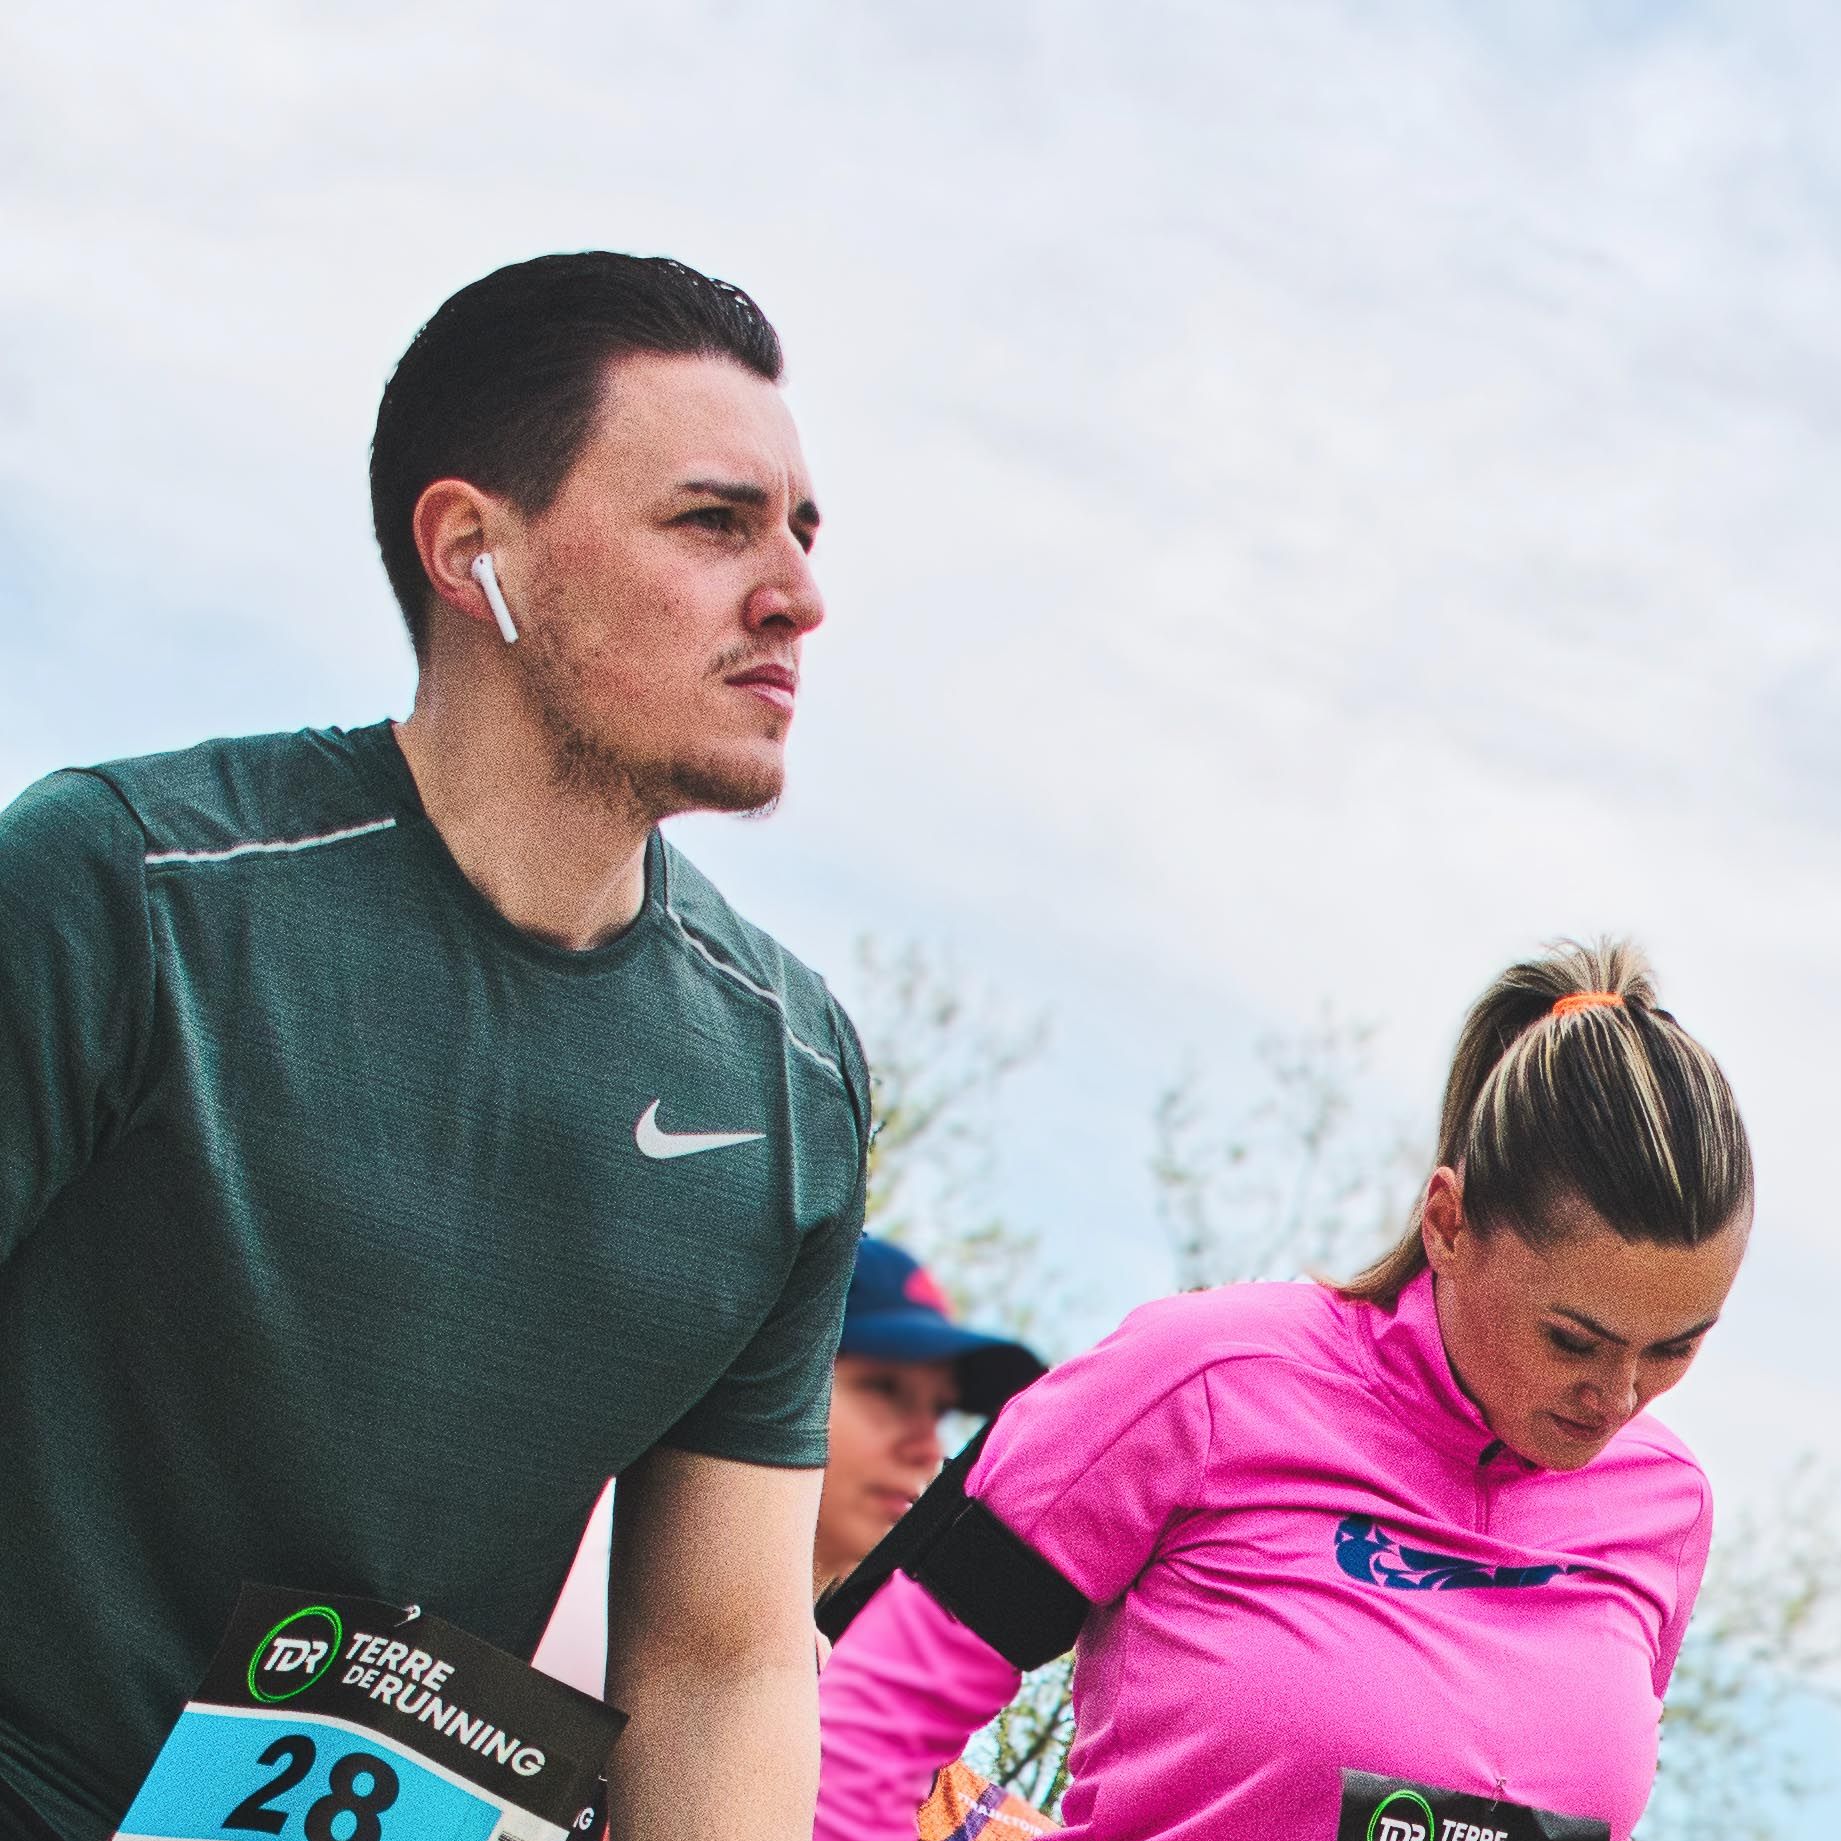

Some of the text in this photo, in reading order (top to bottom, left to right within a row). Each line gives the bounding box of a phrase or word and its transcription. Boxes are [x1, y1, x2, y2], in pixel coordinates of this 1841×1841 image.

[264, 1637, 329, 1675] TDR
[344, 1632, 455, 1692] TERRE
[341, 1665, 546, 1778] DE RUNNING
